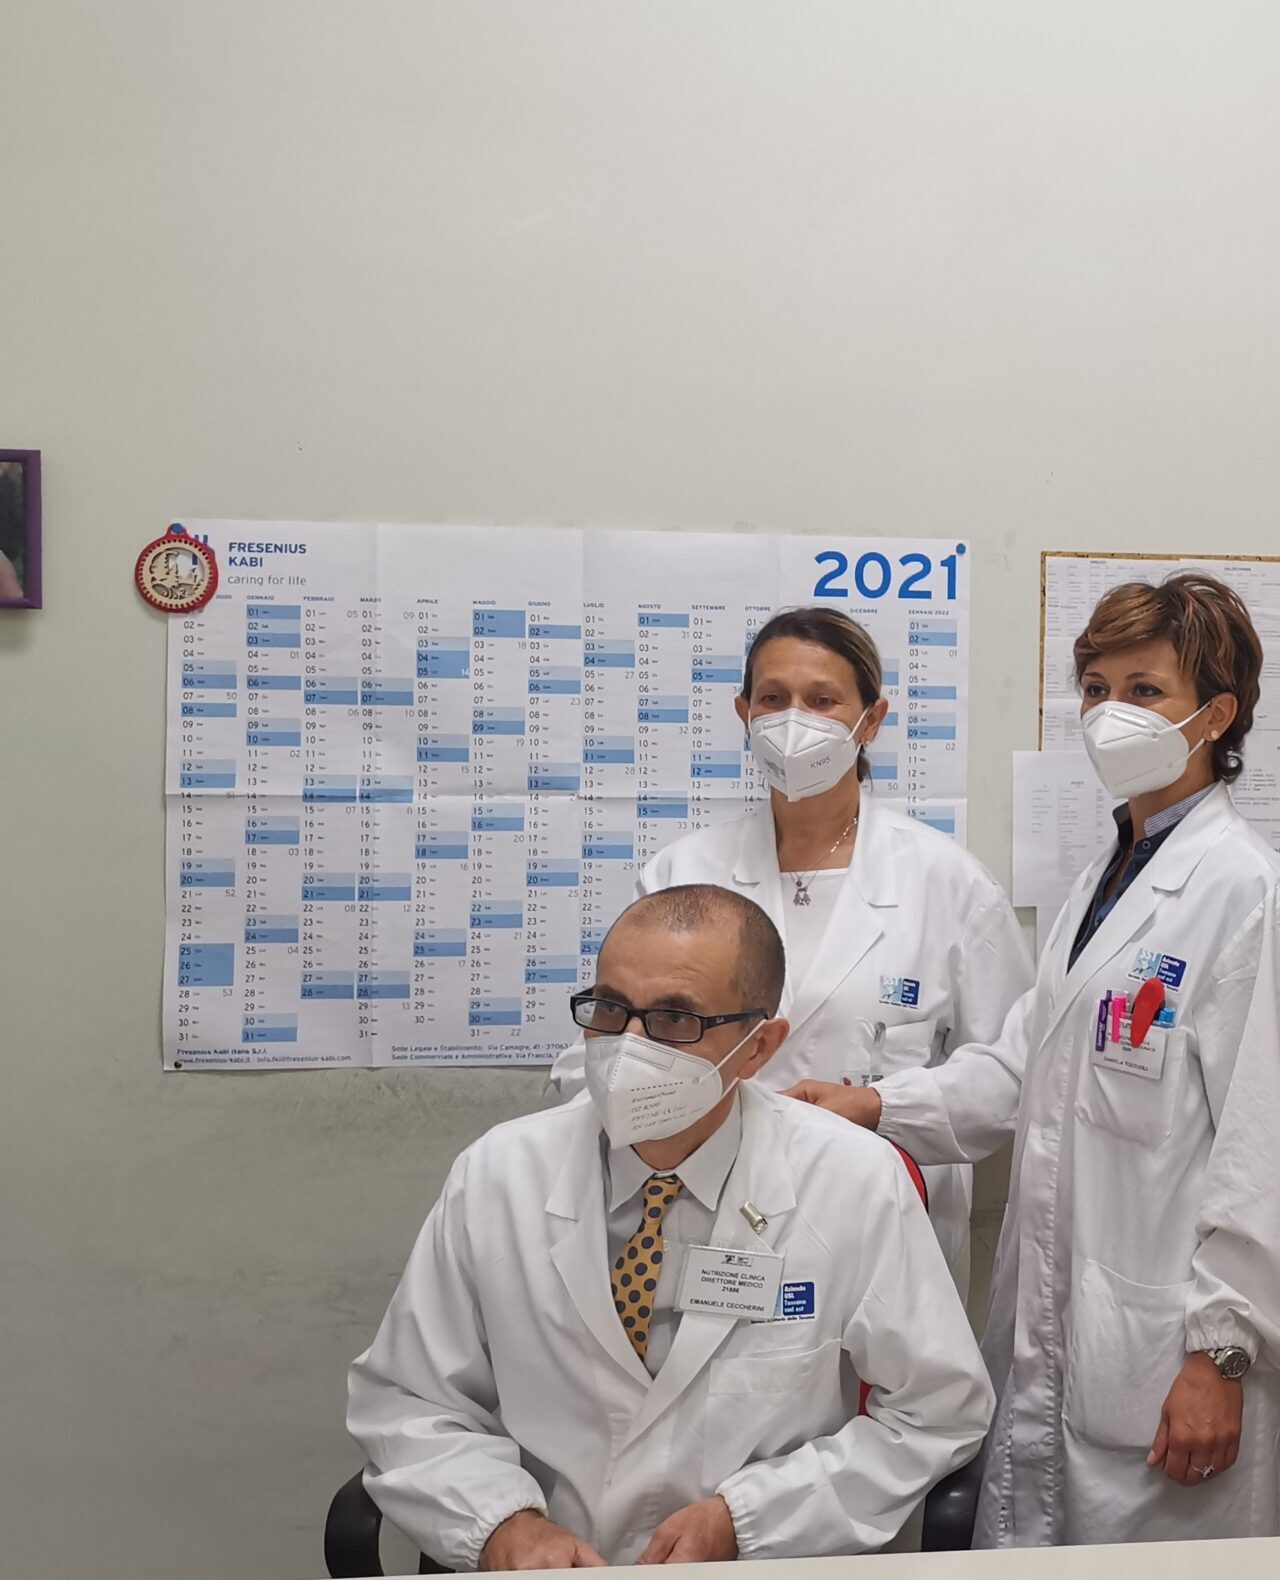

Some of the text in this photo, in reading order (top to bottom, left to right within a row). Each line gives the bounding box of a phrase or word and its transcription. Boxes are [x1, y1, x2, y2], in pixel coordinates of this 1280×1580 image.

[229, 542, 307, 554] FRESENIUS
[228, 556, 263, 567] KABI
[813, 550, 957, 600] 2021
[227, 574, 307, 586] caring for life
[248, 608, 259, 616] 01
[306, 609, 316, 618] 01
[347, 610, 358, 618] 05
[362, 610, 372, 618] 01
[403, 611, 414, 620] 09
[418, 612, 428, 620] 01
[474, 613, 485, 621] 01
[530, 614, 540, 622] 01
[586, 616, 595, 624] 01
[910, 622, 919, 630] 01
[474, 627, 485, 635] 02
[530, 628, 540, 636] 02
[681, 631, 690, 639] 31
[909, 635, 919, 643] 02
[474, 641, 484, 649] 03
[518, 641, 526, 650] 18
[910, 649, 918, 657] 03
[949, 650, 957, 658] 01
[625, 671, 634, 679] 27
[692, 672, 703, 680] 05
[226, 692, 237, 700] 50
[888, 688, 898, 697] 49
[678, 726, 688, 734] 32
[946, 743, 956, 751] 02
[810, 756, 832, 769] KN95
[730, 781, 740, 790] 37
[888, 783, 898, 791] 50
[346, 806, 356, 815] 07
[514, 834, 524, 843] 20
[288, 848, 300, 856] 03
[460, 863, 469, 871] 16
[226, 889, 236, 898] 52
[287, 946, 299, 956] 04
[244, 1032, 254, 1040] 31
[510, 1029, 521, 1037] 22
[701, 1268, 765, 1282] NUTRIZIONE CLINICA
[701, 1276, 763, 1288] DIRETTORE MEDICO
[690, 1298, 764, 1312] EMANUELE CECCHERINI
